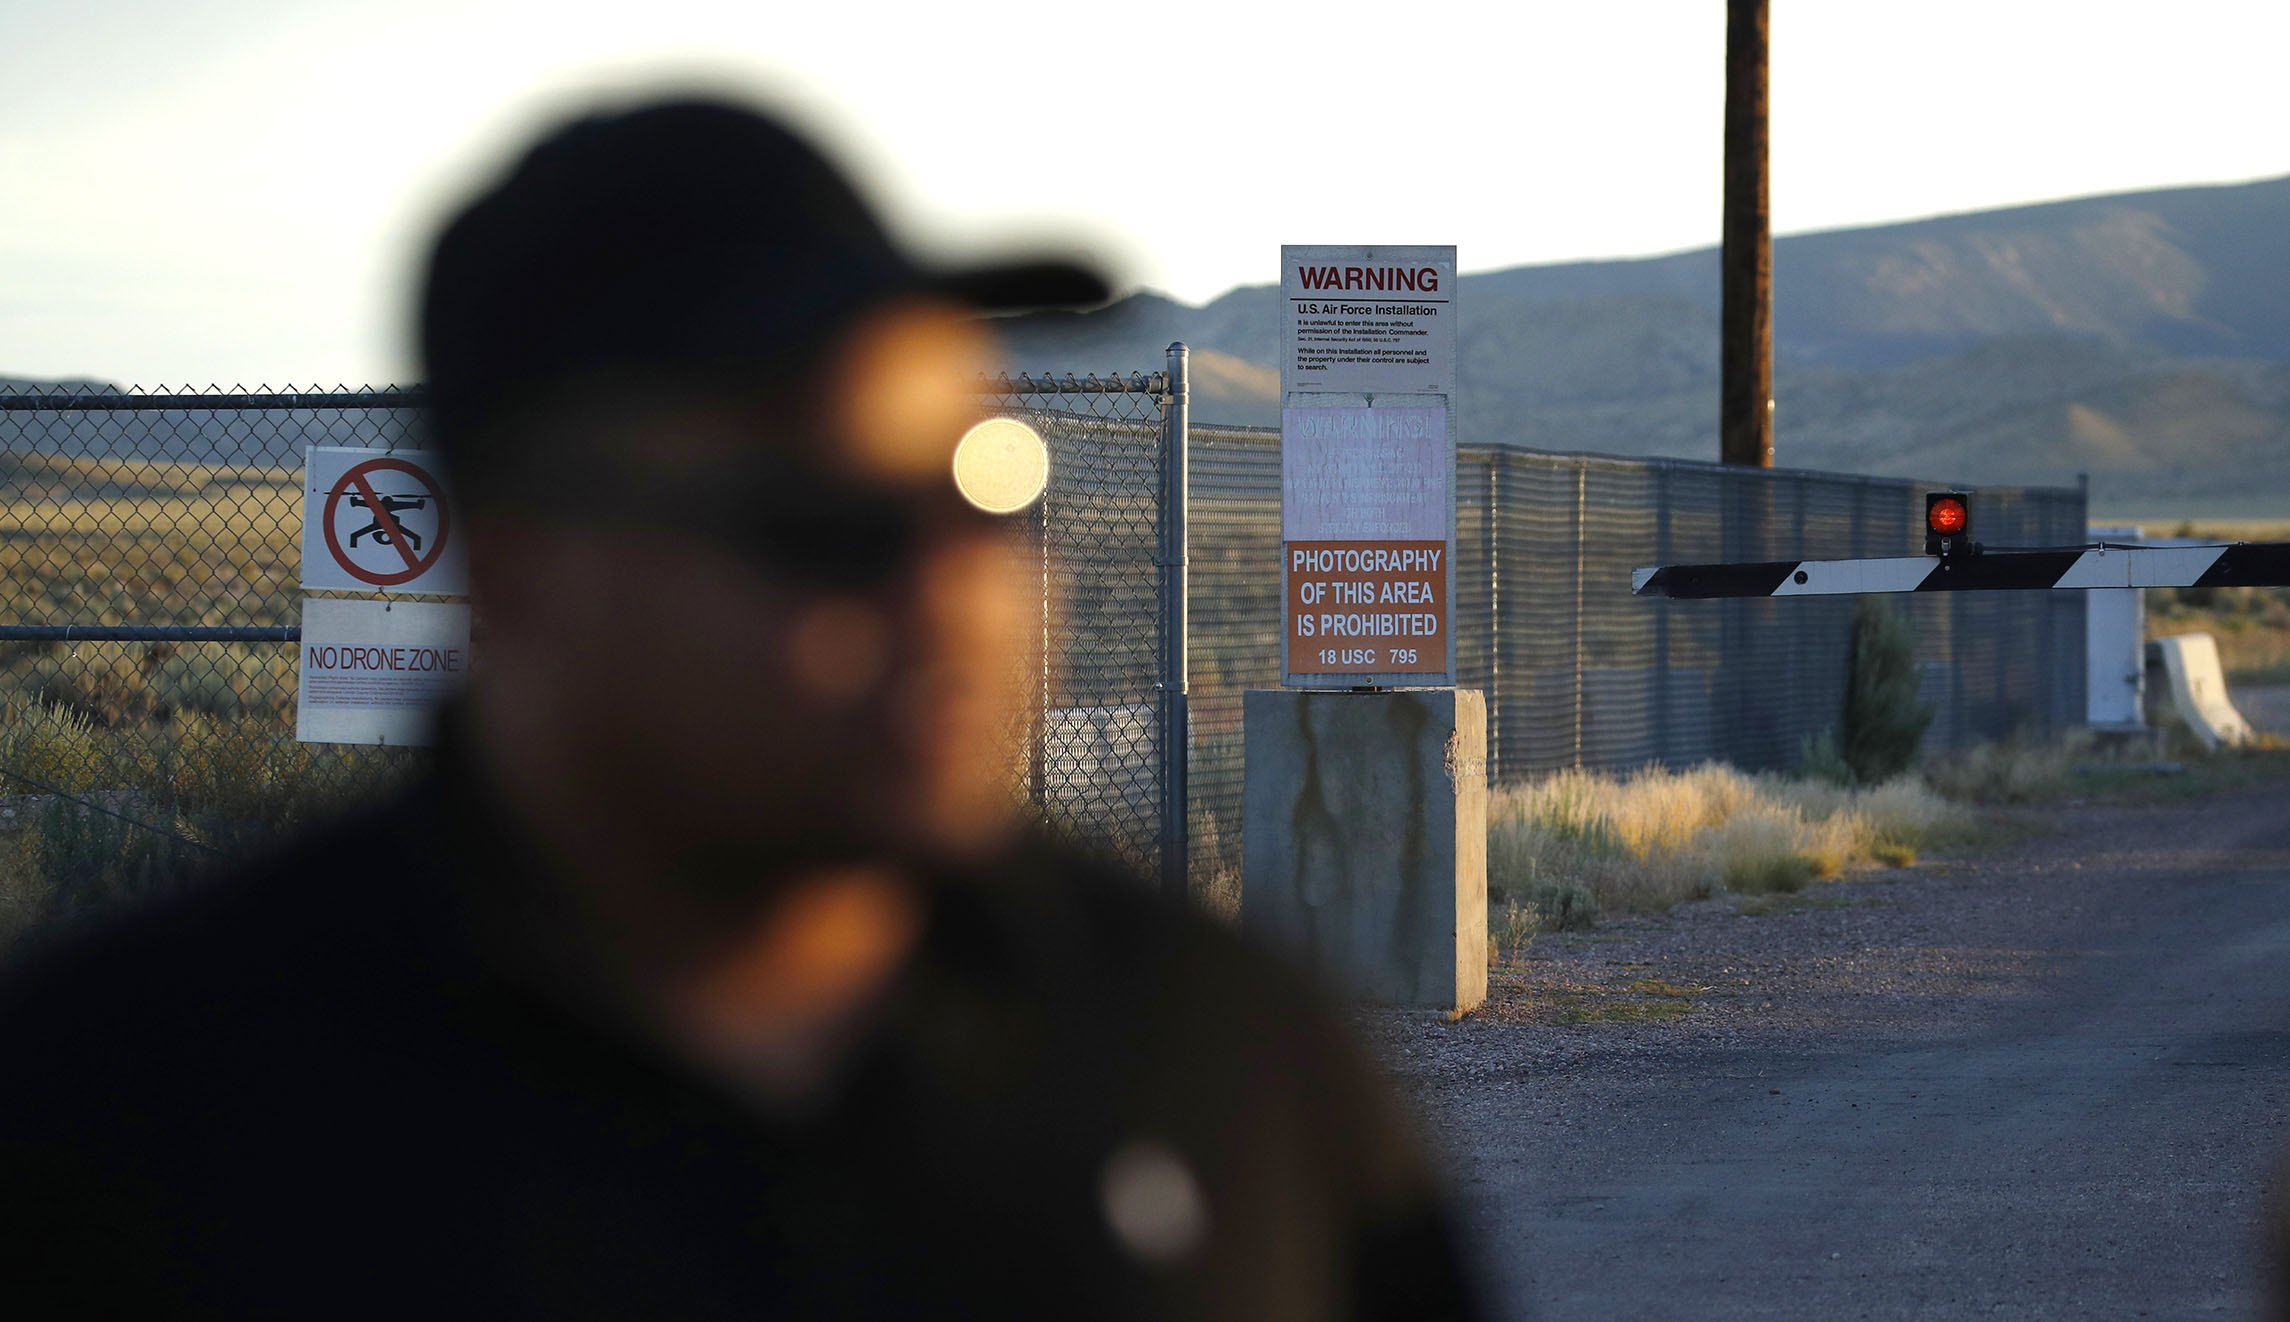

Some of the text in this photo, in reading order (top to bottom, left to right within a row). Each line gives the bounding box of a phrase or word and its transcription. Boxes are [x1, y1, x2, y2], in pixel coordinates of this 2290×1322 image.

[1299, 266, 1438, 292] WARNING
[1298, 304, 1436, 315] U.S. Air Force Installation
[1298, 416, 1431, 439] WARNING!
[1293, 550, 1441, 572] PHOTOGRAPHY
[1301, 582, 1434, 604] OF THIS AREA
[1298, 614, 1437, 636] IS PROHIBITED
[310, 647, 460, 672] NO DRONE ZONE
[1319, 649, 1417, 664] 18 USC 795
